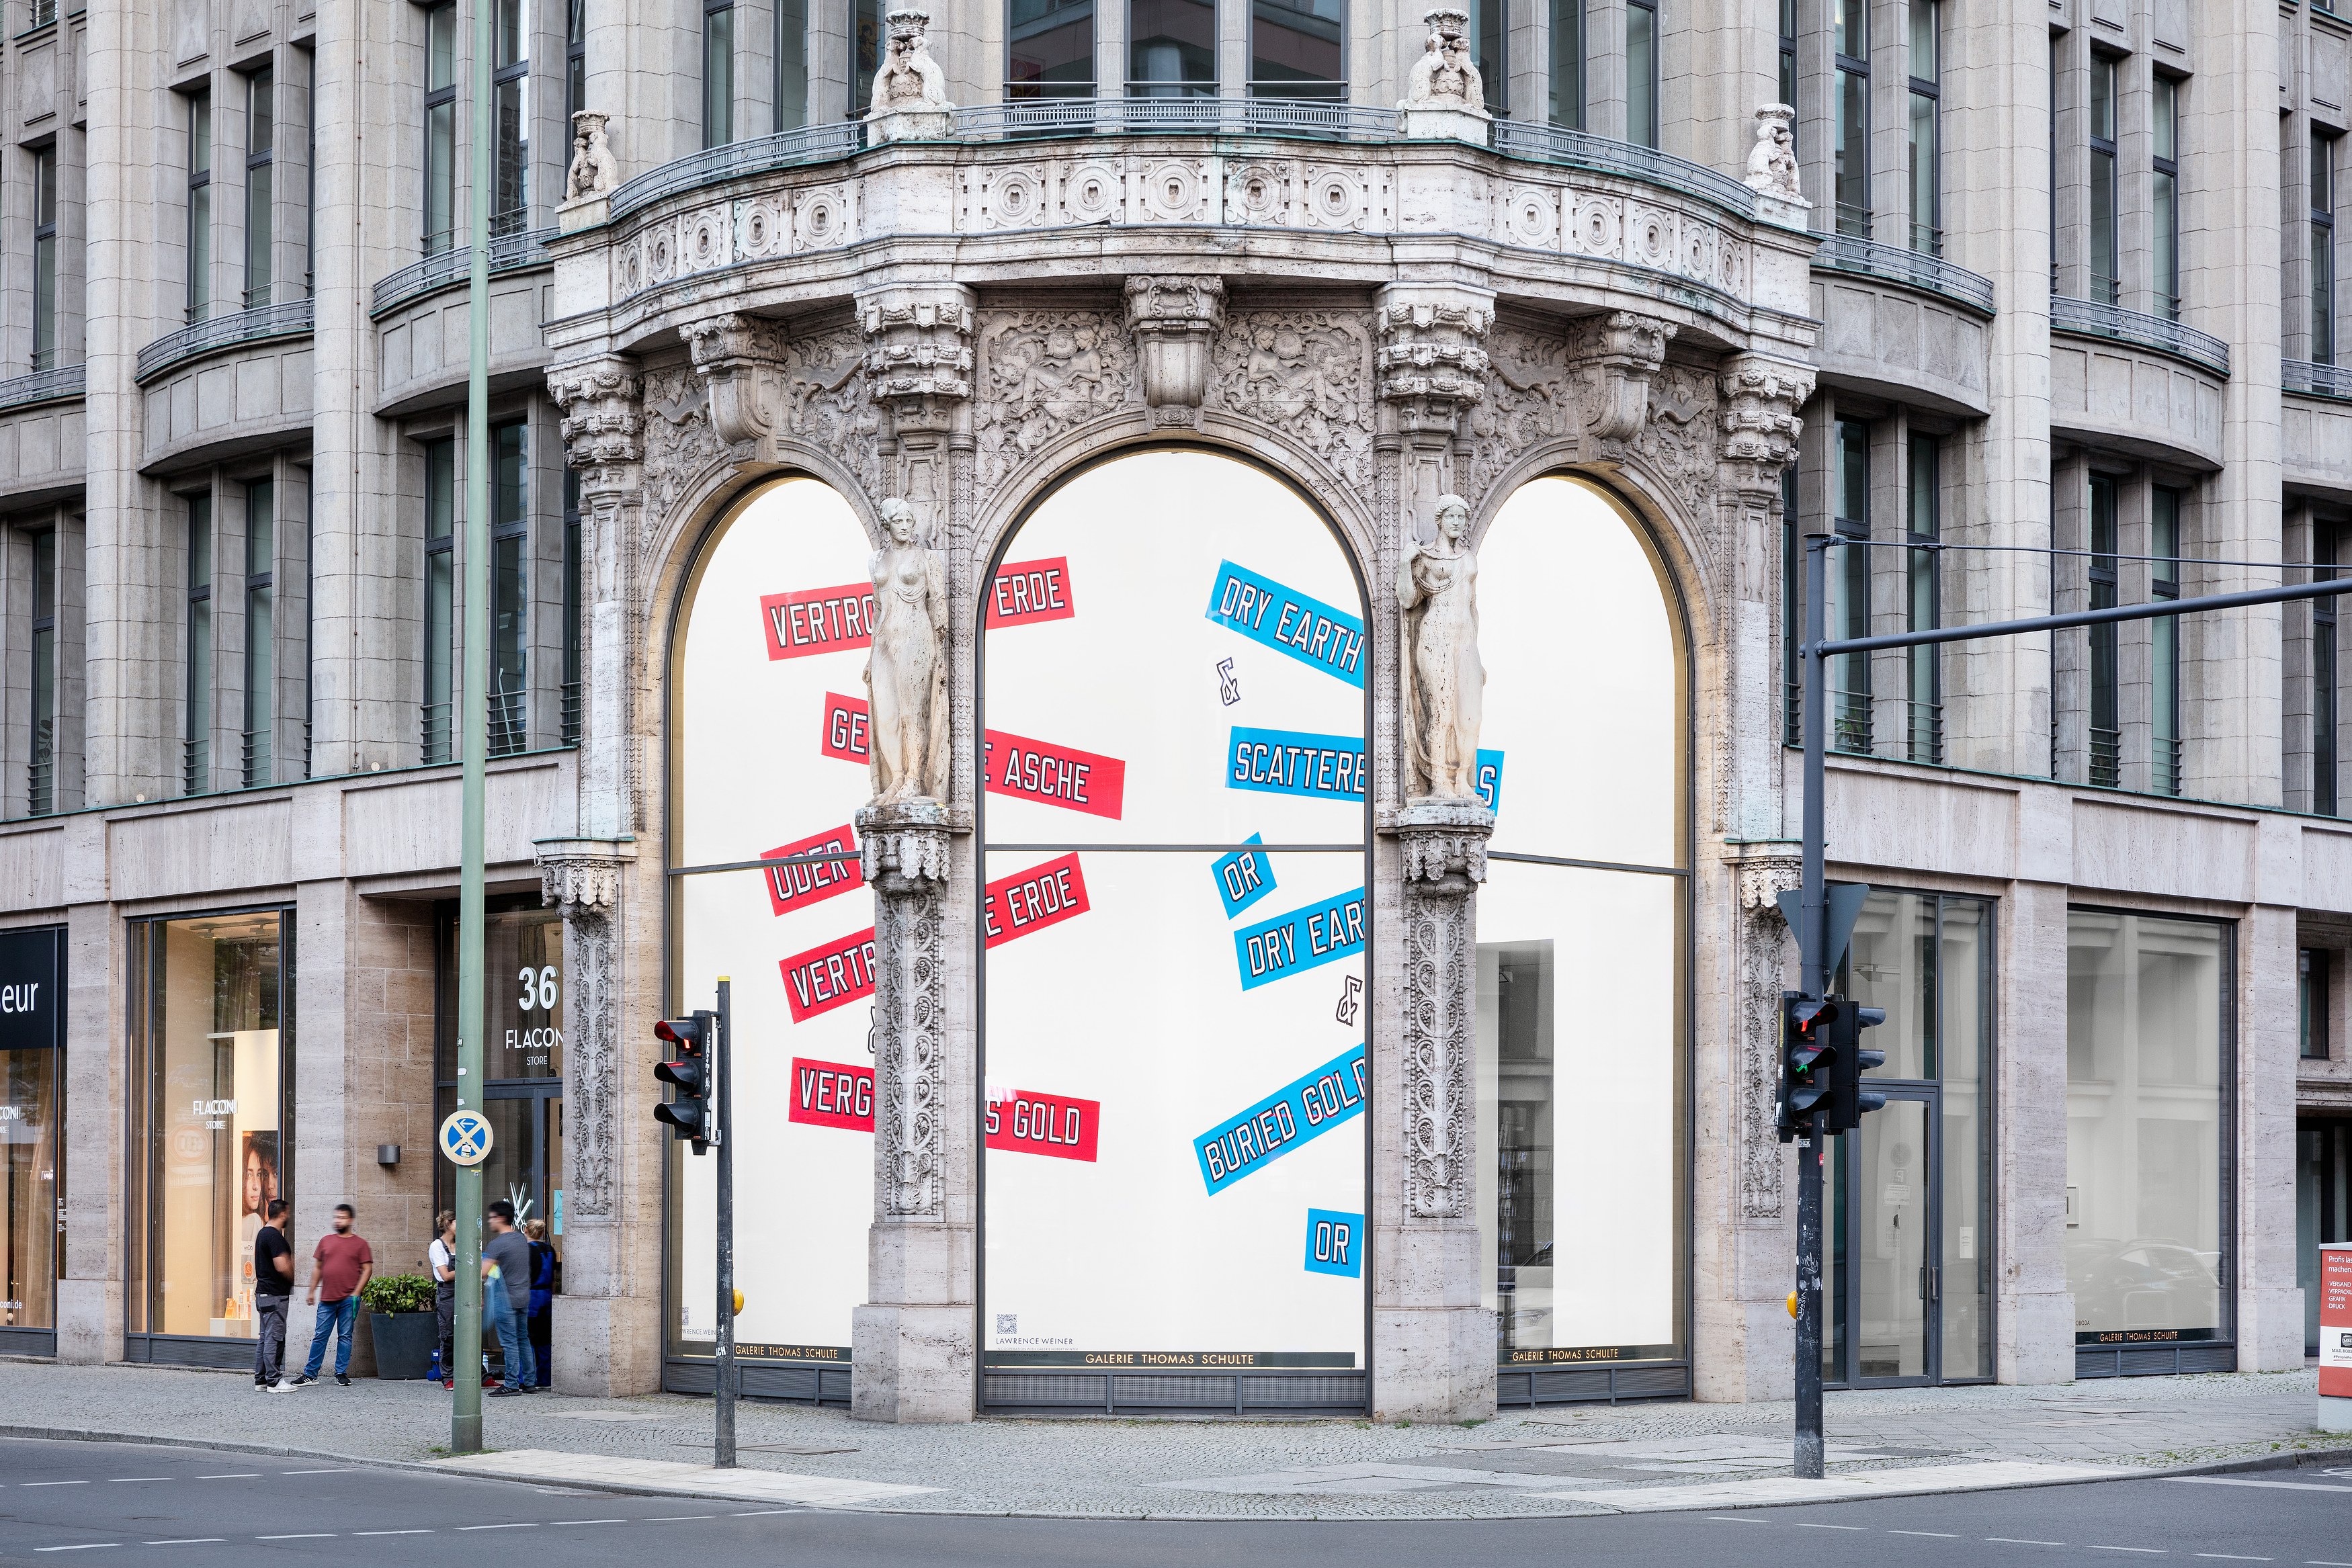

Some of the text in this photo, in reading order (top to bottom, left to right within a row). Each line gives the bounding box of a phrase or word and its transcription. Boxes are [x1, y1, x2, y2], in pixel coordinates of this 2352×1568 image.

[769, 568, 1065, 648] VERTRO ERDE
[1218, 574, 1364, 674] DRY EARTH
[1216, 657, 1241, 706] &
[831, 707, 869, 755] GE
[1003, 748, 1090, 804] ASCHE
[1234, 741, 1364, 794] SCATTERE
[1005, 866, 1078, 928] ERDE
[1223, 851, 1263, 902] OR
[1246, 899, 1364, 977] DRY EAR
[518, 965, 559, 1010] 36
[1336, 975, 1363, 1027] &
[505, 1027, 563, 1049] FLACON
[526, 1055, 548, 1065] STORE
[193, 1099, 237, 1115] FLACONI
[206, 1121, 226, 1129] STORE
[800, 1066, 874, 1119] VERG
[1013, 1098, 1081, 1146] GOLD
[1203, 1056, 1365, 1184] BURIED GOLD
[1314, 1219, 1351, 1266] OR
[735, 1345, 838, 1358] GALERIE THOMAS SCHULTE
[1085, 1354, 1254, 1364] GALERIE THOMAS SCHULTE
[1513, 1348, 1618, 1361] GALERIE THOMAS SCHULTE
[2099, 1331, 2178, 1342] GALERIE THOMAS SCHULTE
